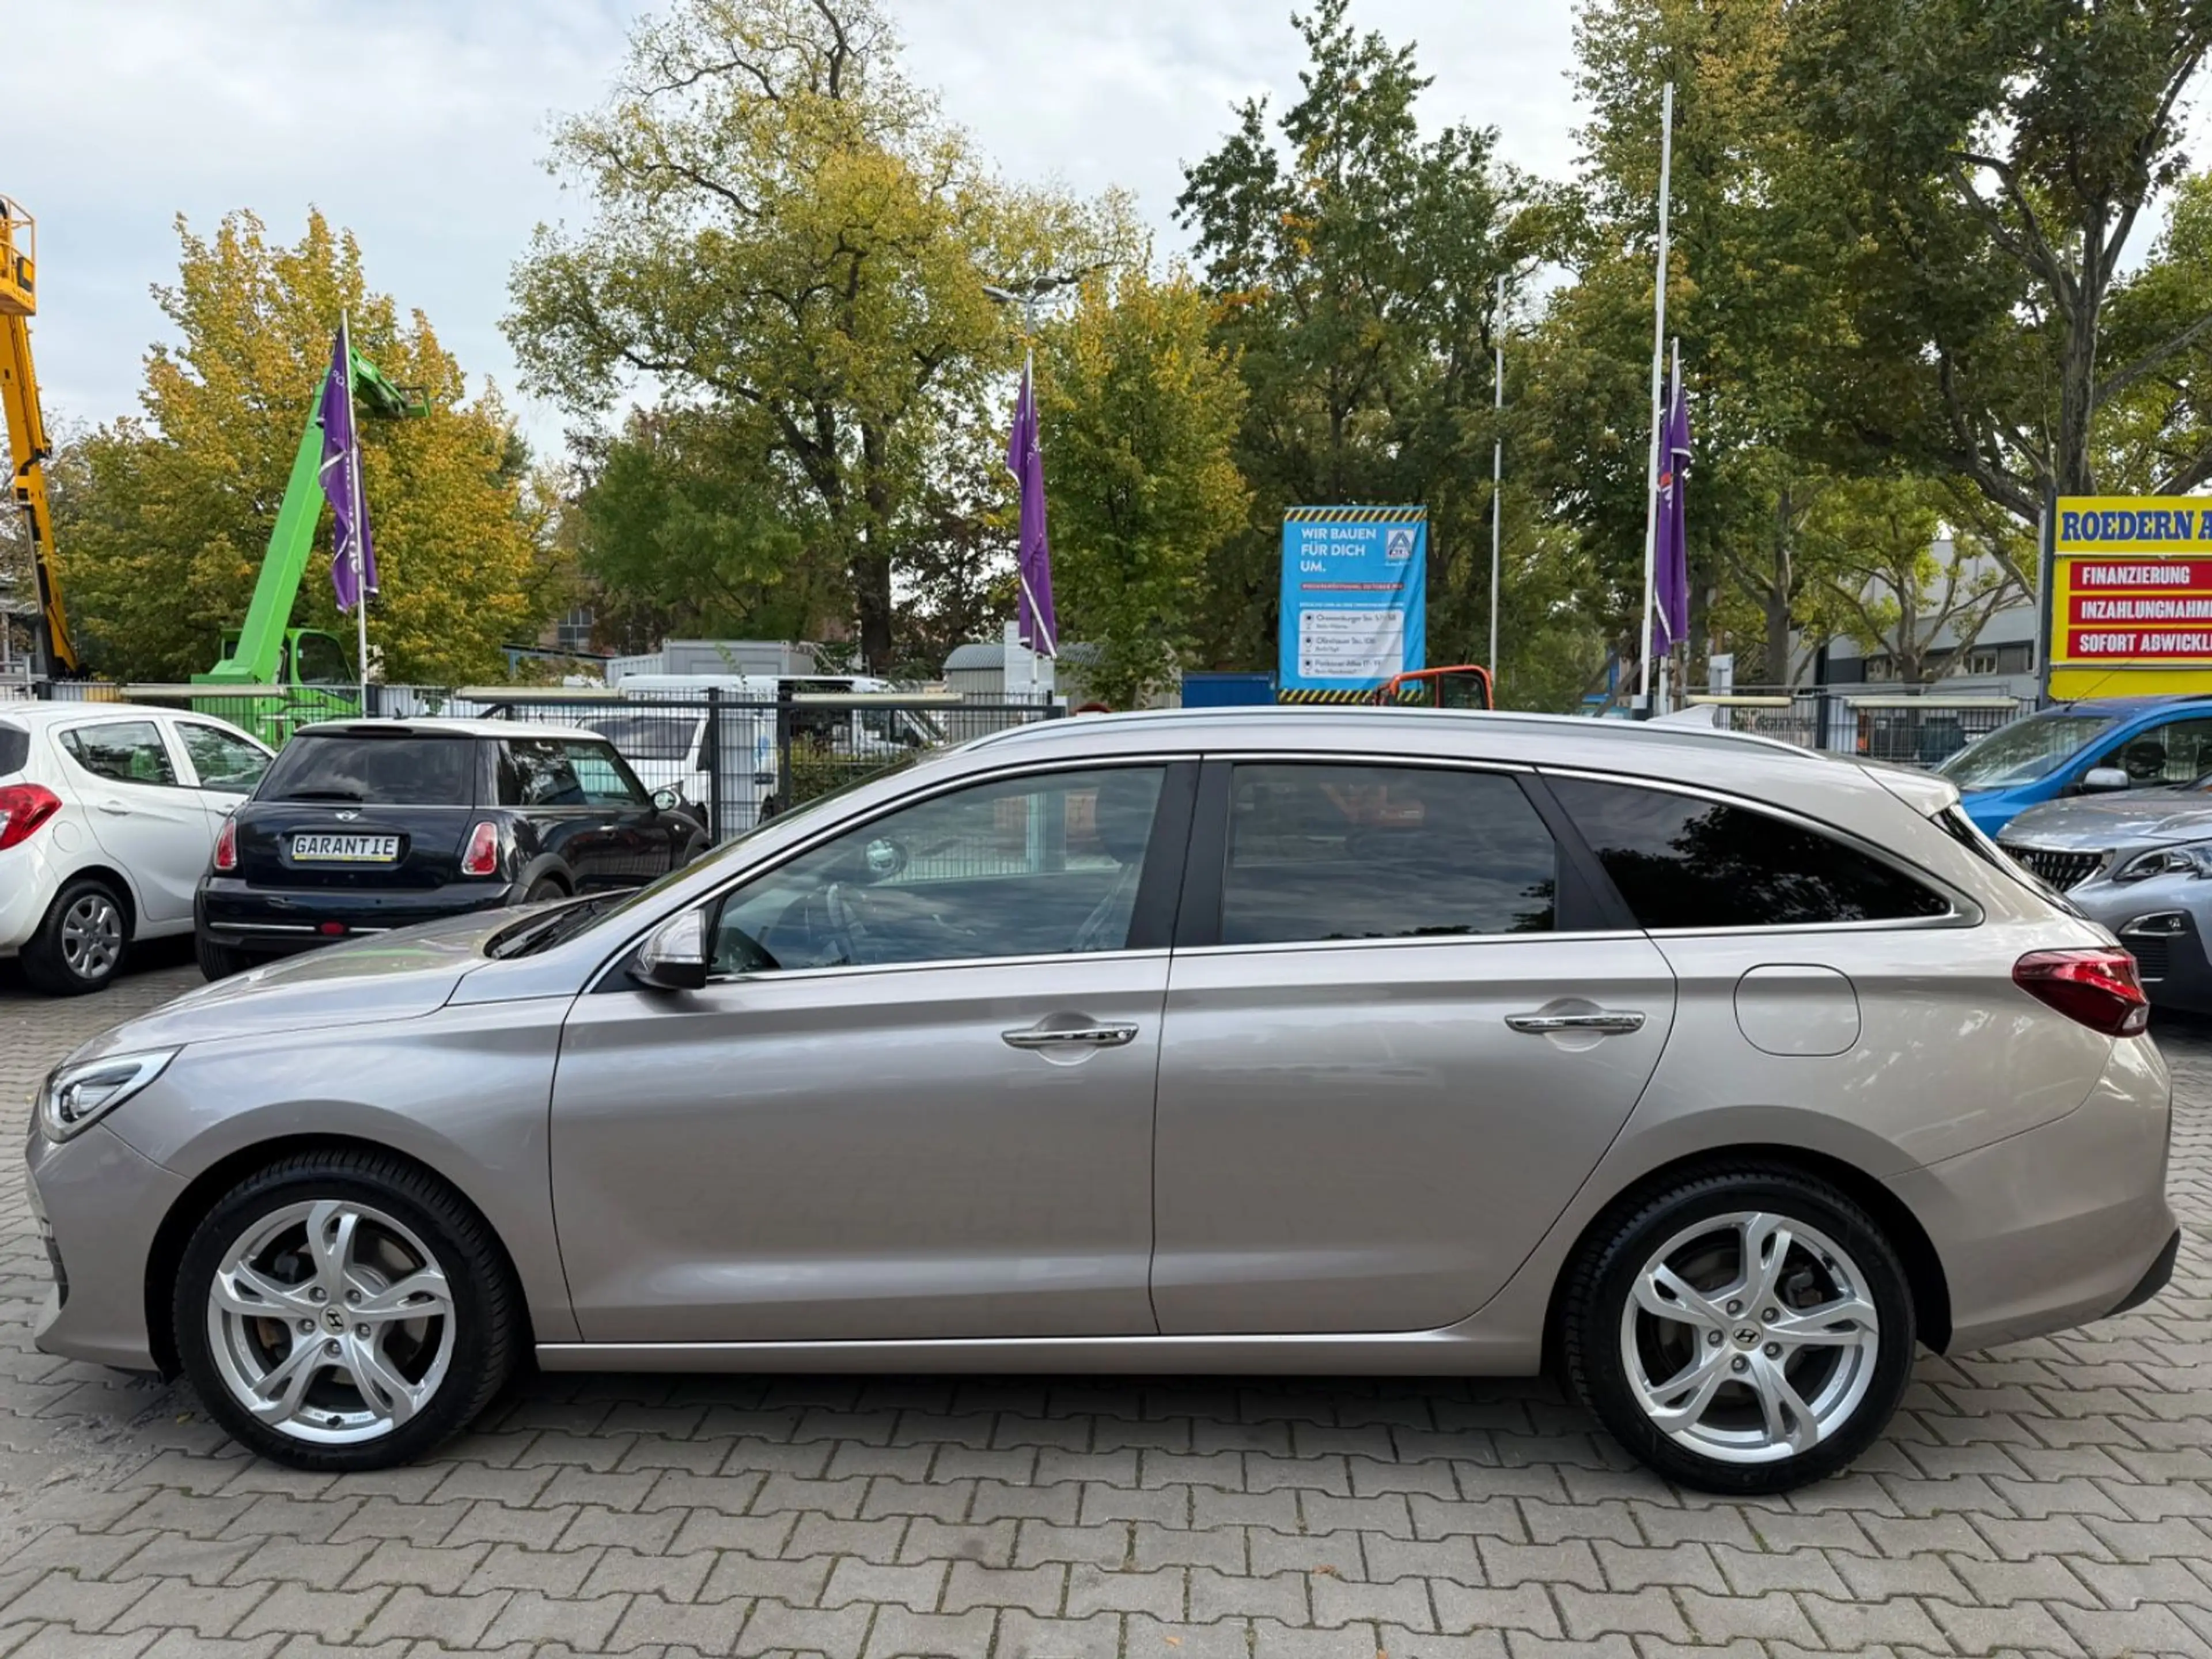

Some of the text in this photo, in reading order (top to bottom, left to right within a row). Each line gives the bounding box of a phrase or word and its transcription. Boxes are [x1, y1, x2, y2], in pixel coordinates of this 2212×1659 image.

[1301, 528, 1377, 540] WIR BAUEN
[2061, 511, 2194, 541] ROEDERN
[1301, 541, 1366, 556] FÜR DICH
[1300, 560, 1326, 573] UM.
[2082, 566, 2190, 585] FINANZIERUNG
[2079, 634, 2137, 652] SOFORT
[295, 837, 395, 855] GARANTIE
